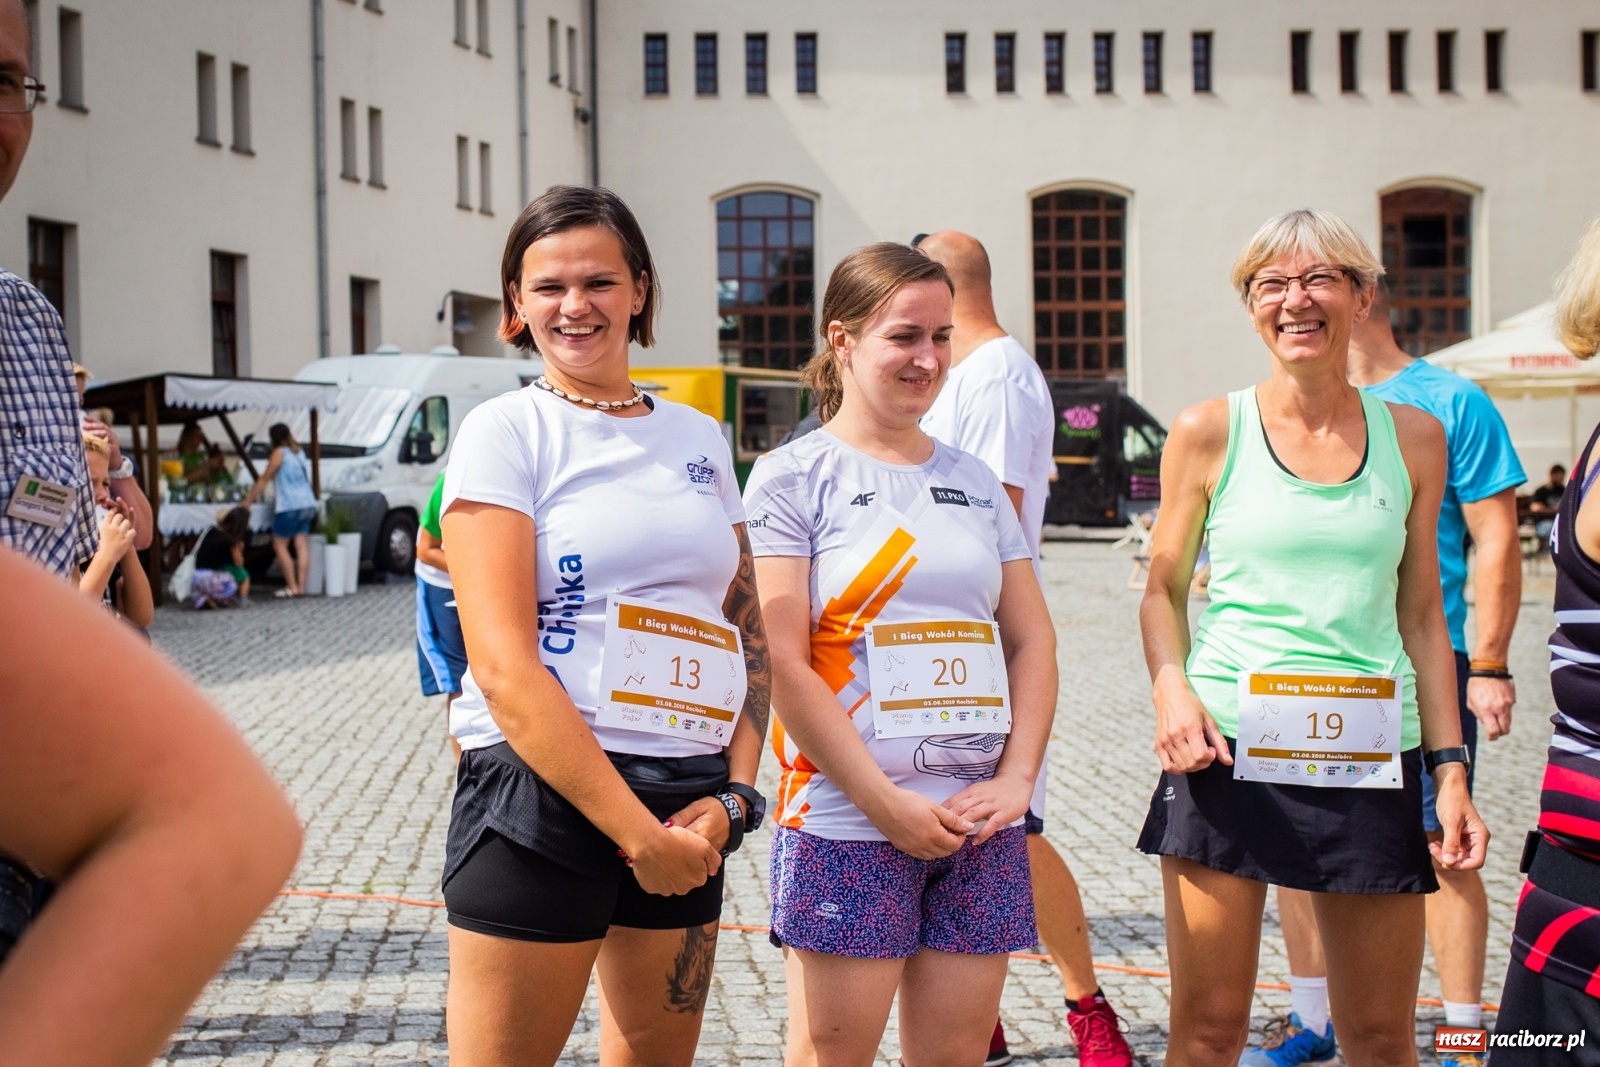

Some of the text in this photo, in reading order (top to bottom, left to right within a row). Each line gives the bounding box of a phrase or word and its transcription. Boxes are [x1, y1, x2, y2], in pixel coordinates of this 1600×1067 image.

[850, 492, 876, 506] 4F
[947, 492, 965, 502] PKO
[646, 619, 667, 631] Bieg
[670, 623, 697, 636] Wokół
[698, 630, 727, 645] Komina
[900, 632, 923, 641] Bieg
[926, 630, 955, 639] Wokół
[958, 630, 985, 639] Komina
[669, 655, 701, 690] 13
[932, 657, 967, 686] 20
[1276, 684, 1300, 694] Bieg
[1303, 684, 1336, 693] Wokół
[1339, 685, 1378, 695] Komina
[1306, 712, 1344, 740] 19
